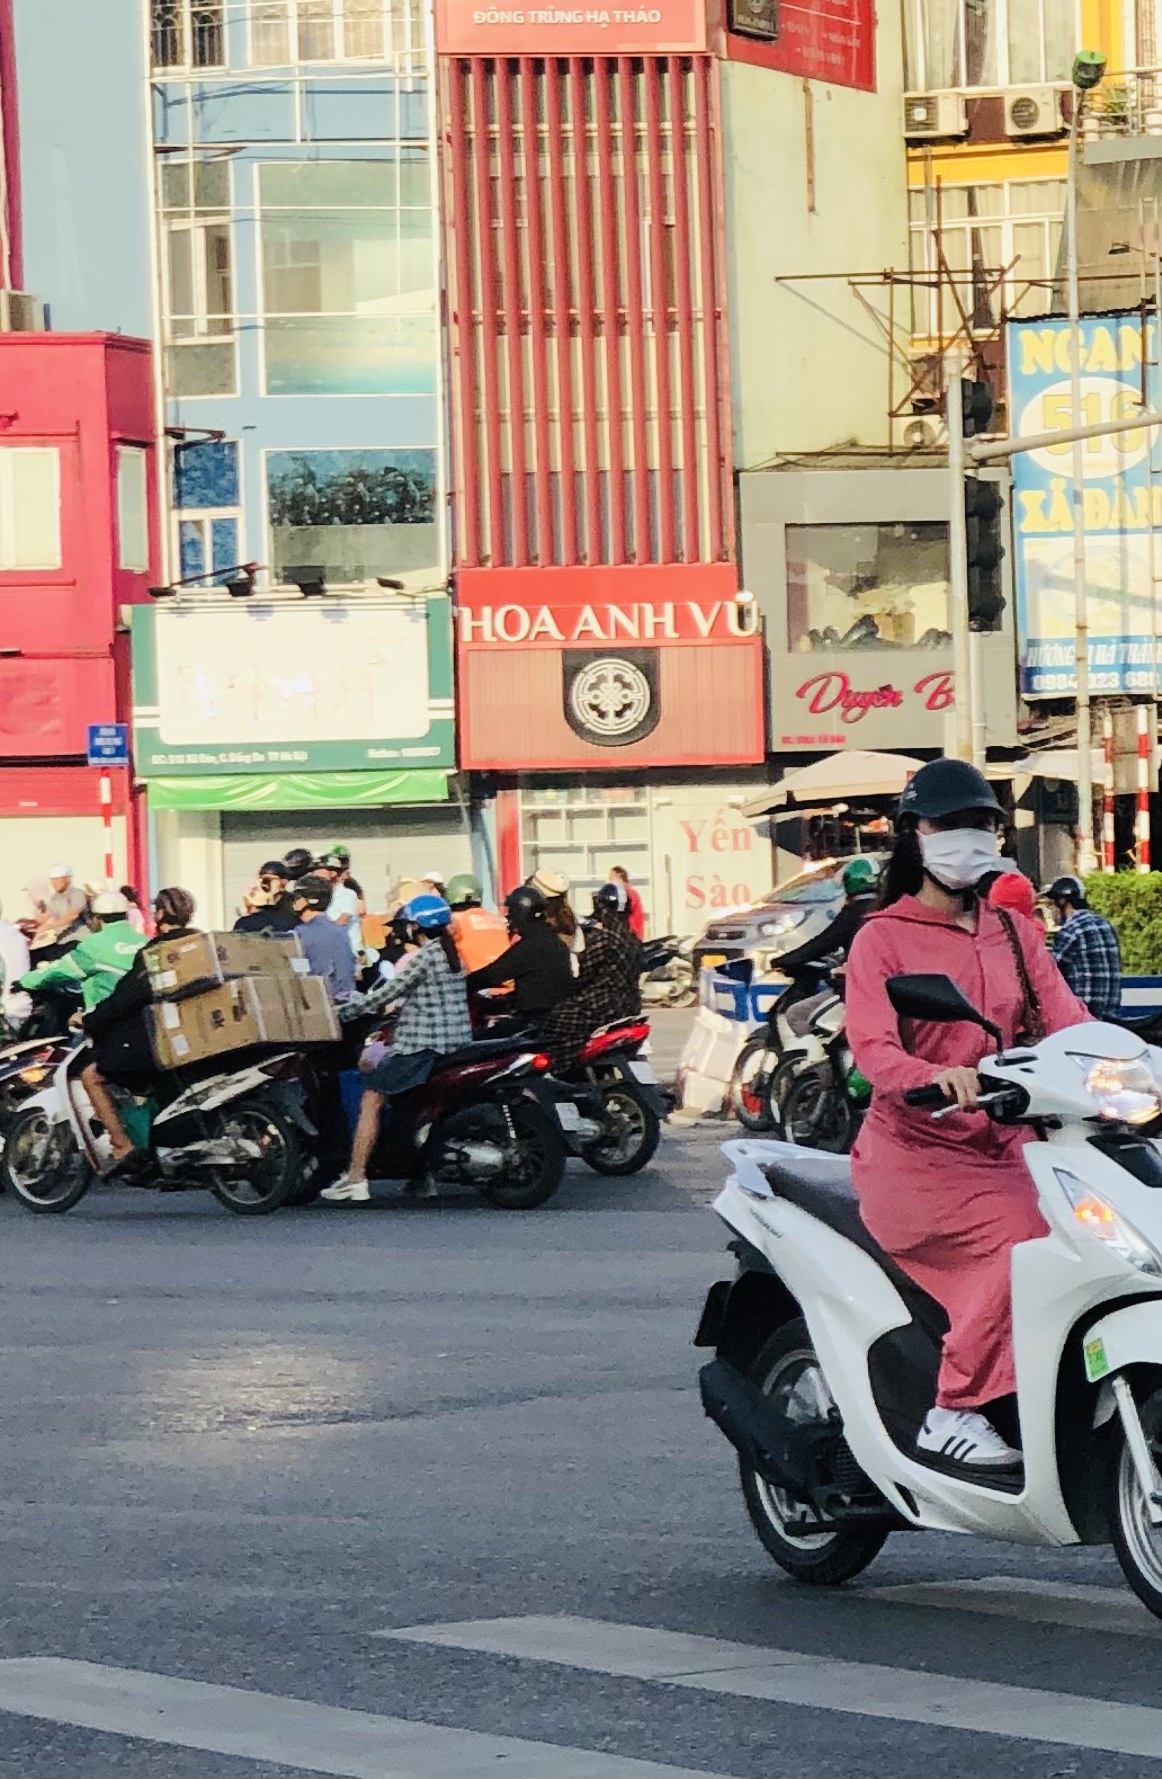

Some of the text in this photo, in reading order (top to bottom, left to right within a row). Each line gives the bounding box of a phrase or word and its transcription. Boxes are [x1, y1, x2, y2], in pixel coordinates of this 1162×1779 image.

[1042, 390, 1146, 457] 516
[459, 603, 566, 642] HOA
[571, 601, 680, 640] ANH
[685, 873, 752, 910] Sào
